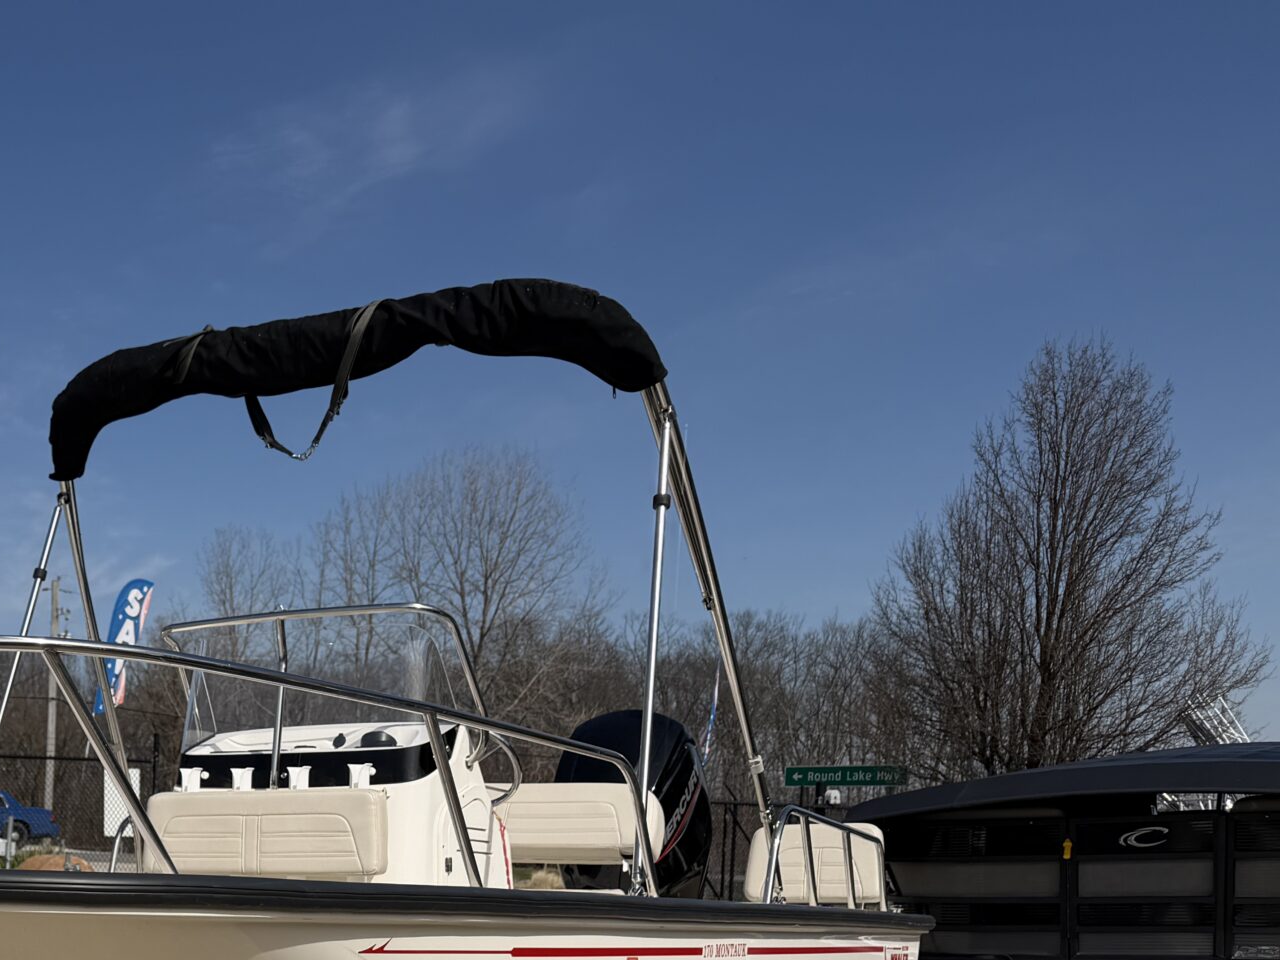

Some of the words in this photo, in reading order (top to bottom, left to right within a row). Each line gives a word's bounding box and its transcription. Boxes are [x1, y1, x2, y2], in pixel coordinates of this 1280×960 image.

[807, 770, 841, 781] Round
[846, 770, 872, 781] Lake
[715, 943, 747, 958] MONTAUK
